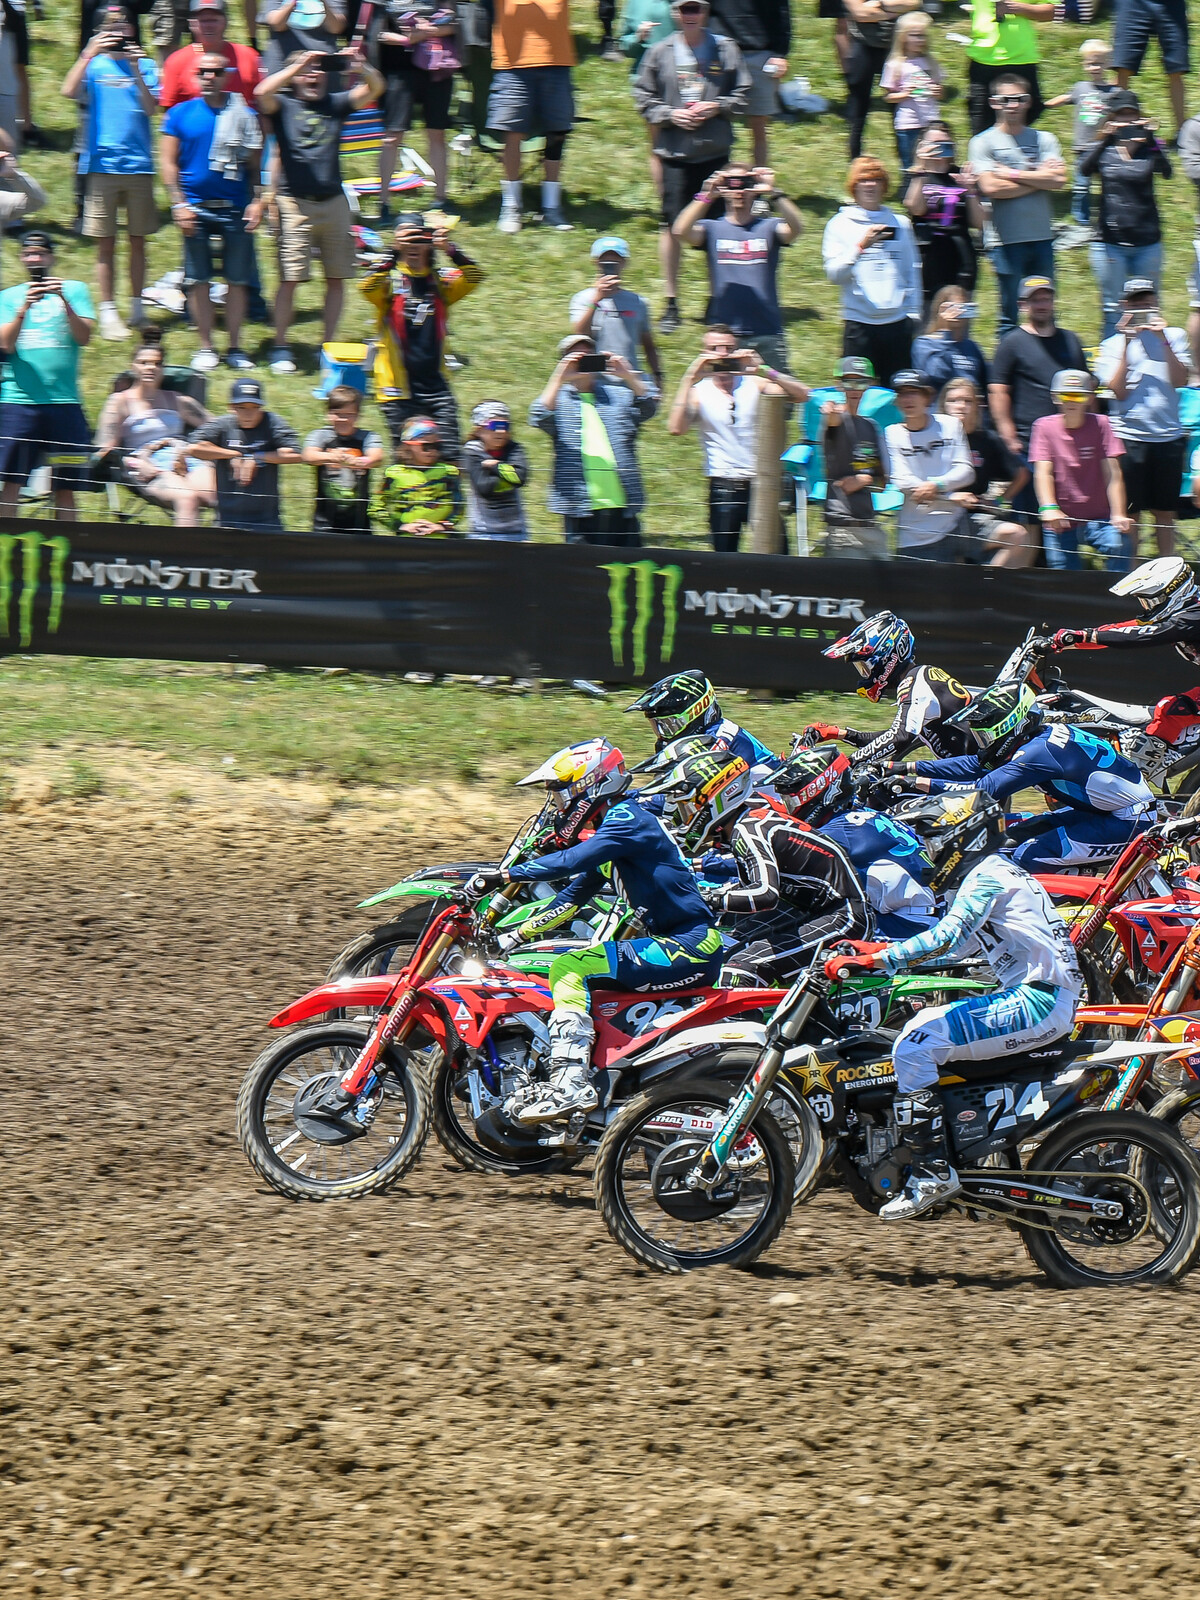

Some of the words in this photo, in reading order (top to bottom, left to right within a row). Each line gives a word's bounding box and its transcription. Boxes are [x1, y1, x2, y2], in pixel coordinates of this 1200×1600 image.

[72, 557, 261, 594] MONSTER
[100, 595, 234, 610] ENERGY
[684, 587, 866, 623] MONSTER
[711, 623, 840, 640] ENERGY
[725, 784, 739, 798] BELL
[798, 766, 839, 803] 100%
[531, 901, 574, 929] HONDA
[1074, 907, 1105, 951] SHOWA
[651, 972, 706, 992] HONDA
[383, 990, 418, 1044] SHOWA
[844, 1077, 876, 1090] ENERGY
[877, 1074, 898, 1086] DRIN
[1113, 1065, 1137, 1103] MOTOREX
[724, 1097, 752, 1137] MOTOREX
[985, 1080, 1051, 1131] 24
[690, 1118, 714, 1130] DID
[979, 1186, 1005, 1196] EXCEL
